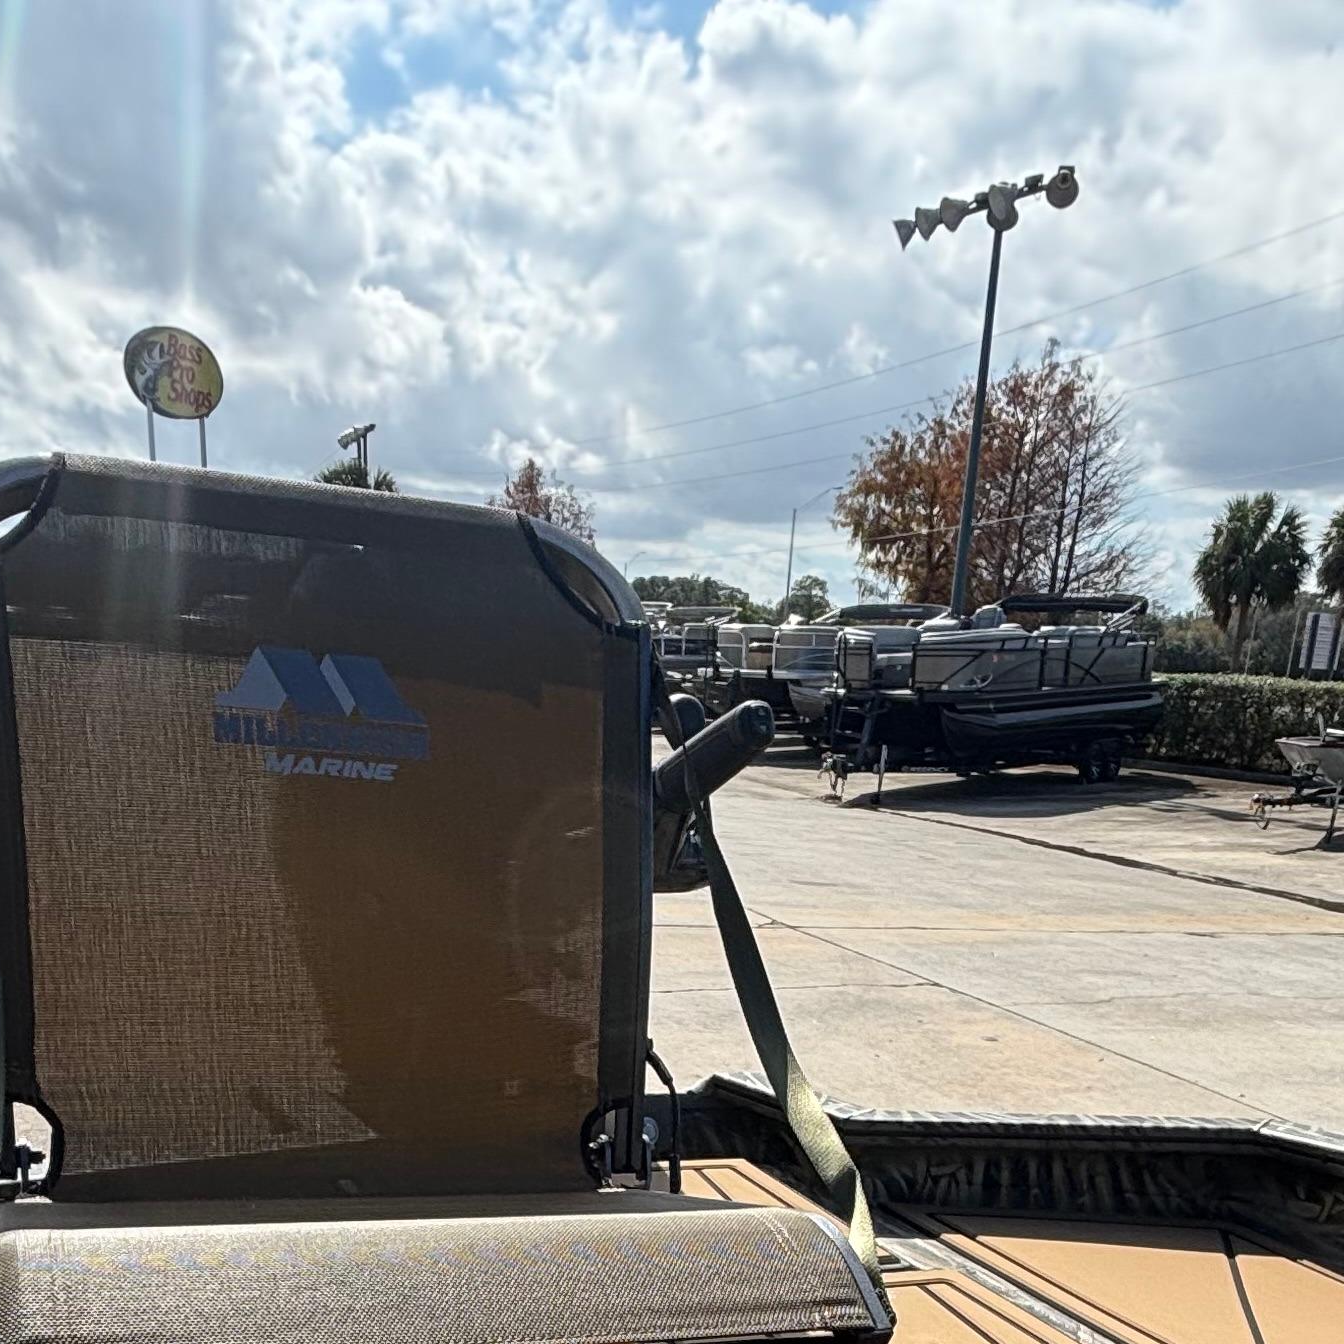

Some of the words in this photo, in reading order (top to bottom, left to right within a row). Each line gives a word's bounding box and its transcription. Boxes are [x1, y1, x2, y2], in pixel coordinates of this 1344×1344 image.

[167, 334, 202, 364] Bass
[168, 360, 195, 382] Pro
[167, 380, 213, 413] Shops
[263, 751, 399, 782] MARINE
